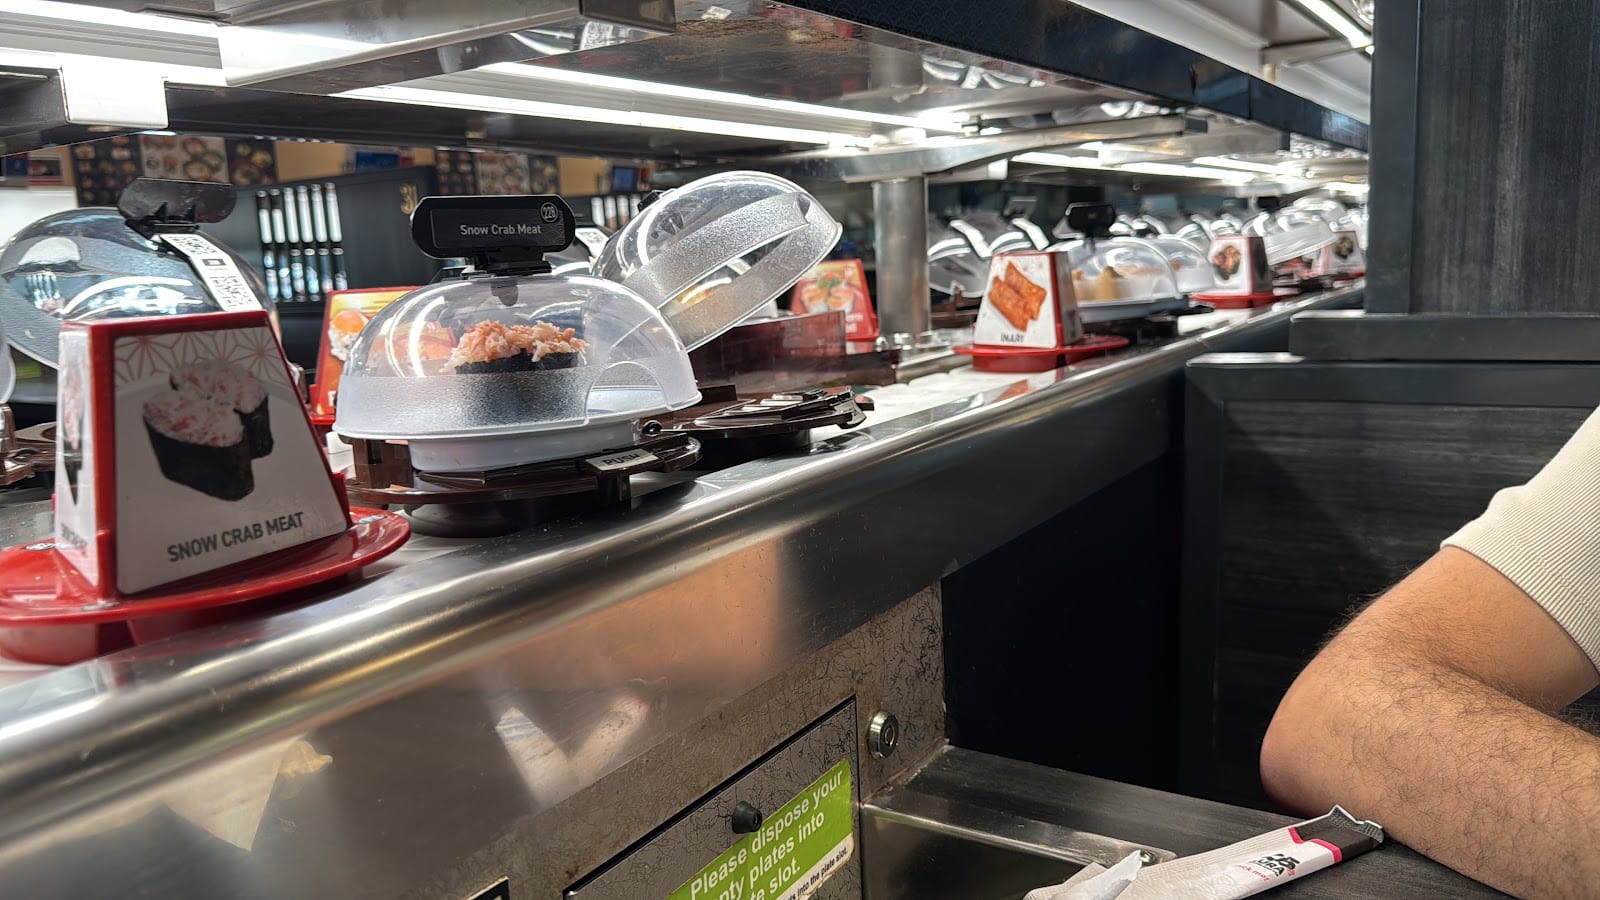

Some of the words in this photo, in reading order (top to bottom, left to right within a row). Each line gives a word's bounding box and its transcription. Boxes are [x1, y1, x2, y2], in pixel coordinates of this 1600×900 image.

[460, 224, 489, 236] Snow
[491, 224, 515, 235] Crab
[517, 223, 542, 234] Meat
[603, 453, 640, 466] PUSH
[167, 533, 218, 562] SNOW
[221, 523, 263, 547] CRAB
[265, 511, 304, 536] MEAT
[691, 848, 747, 900] Please
[752, 798, 809, 853] dispose
[813, 770, 842, 810] your
[750, 837, 794, 889] plates
[799, 811, 824, 843] into
[769, 856, 800, 894] slot.
[797, 881, 810, 898] into
[810, 871, 820, 886] the
[821, 858, 835, 878] plate
